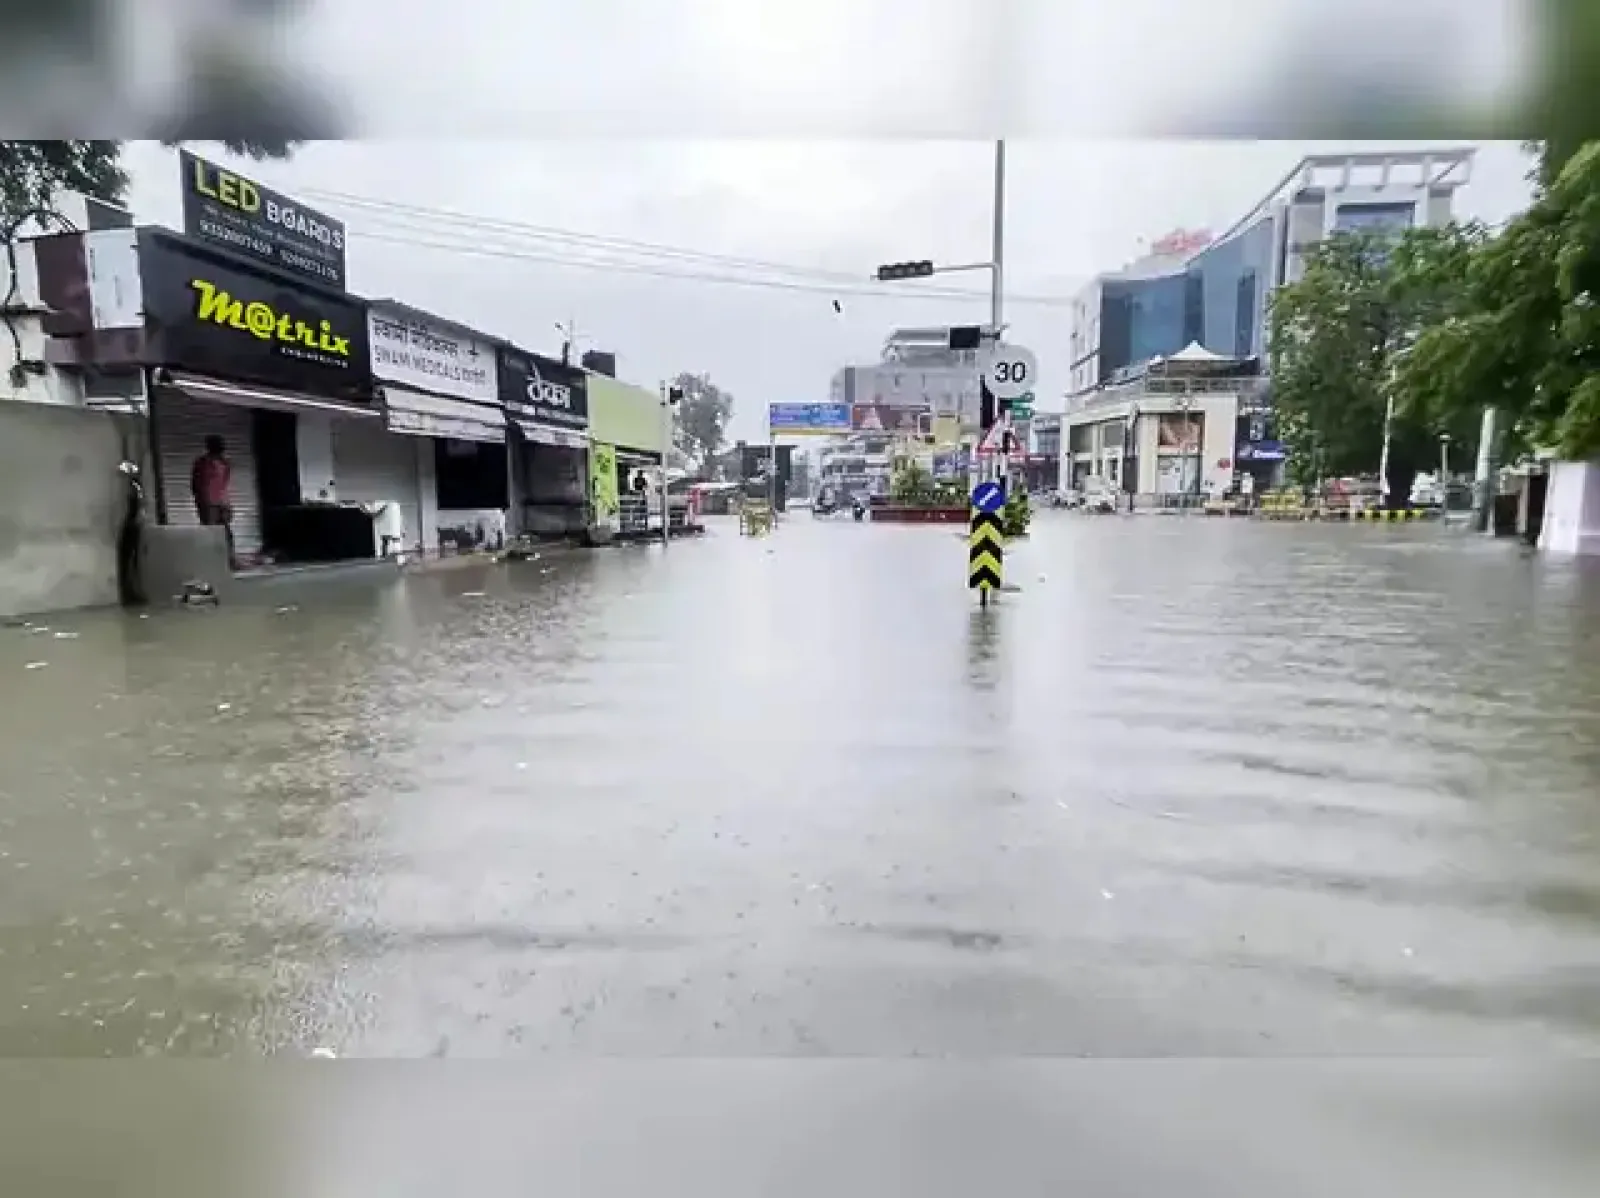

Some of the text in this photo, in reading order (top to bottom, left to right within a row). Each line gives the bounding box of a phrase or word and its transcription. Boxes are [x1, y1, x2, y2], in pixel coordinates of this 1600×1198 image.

[195, 159, 261, 211] LED
[266, 200, 343, 249] BOARDS
[994, 361, 1026, 383] 30
